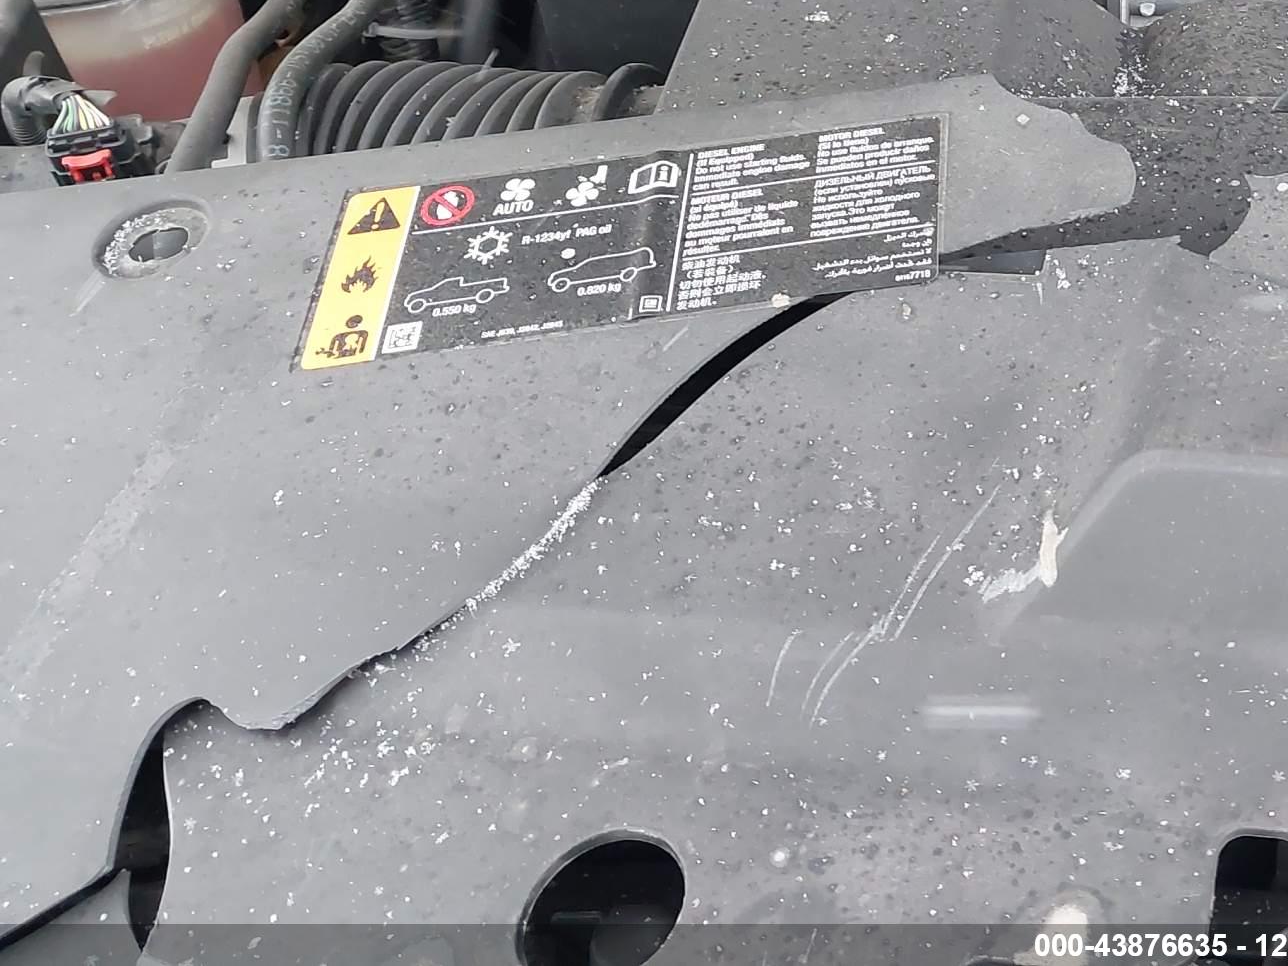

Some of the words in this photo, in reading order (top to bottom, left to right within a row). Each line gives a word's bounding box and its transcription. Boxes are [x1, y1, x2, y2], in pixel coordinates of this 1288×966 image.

[819, 132, 852, 142] MOTOR
[853, 127, 885, 138] DIESEL
[697, 148, 730, 159] DIESEL
[731, 143, 766, 155] ENGINE
[817, 150, 830, 158] No
[880, 141, 892, 149] de
[695, 166, 708, 175] Do
[709, 164, 725, 173] not
[725, 163, 743, 171] use
[743, 158, 778, 170] starting
[742, 166, 773, 176] engine
[774, 161, 811, 173] damage
[816, 158, 829, 166] Se
[866, 159, 878, 167] en
[879, 157, 889, 165] el
[692, 183, 710, 191] can
[690, 193, 730, 205] MOTEUR
[731, 188, 764, 200] DIESEL
[493, 199, 534, 216] AUTO
[688, 213, 702, 222] Ne
[702, 211, 720, 221] pas
[767, 200, 800, 212] liquide
[521, 229, 572, 245] R-1234yf
[575, 225, 597, 238] PAG
[598, 223, 613, 235] oil
[684, 239, 697, 248] au
[698, 234, 732, 245] moteur
[732, 226, 780, 241] pourraient
[781, 225, 794, 234] en
[685, 225, 737, 239] dommages
[607, 282, 622, 293] kg
[463, 303, 477, 315] kg
